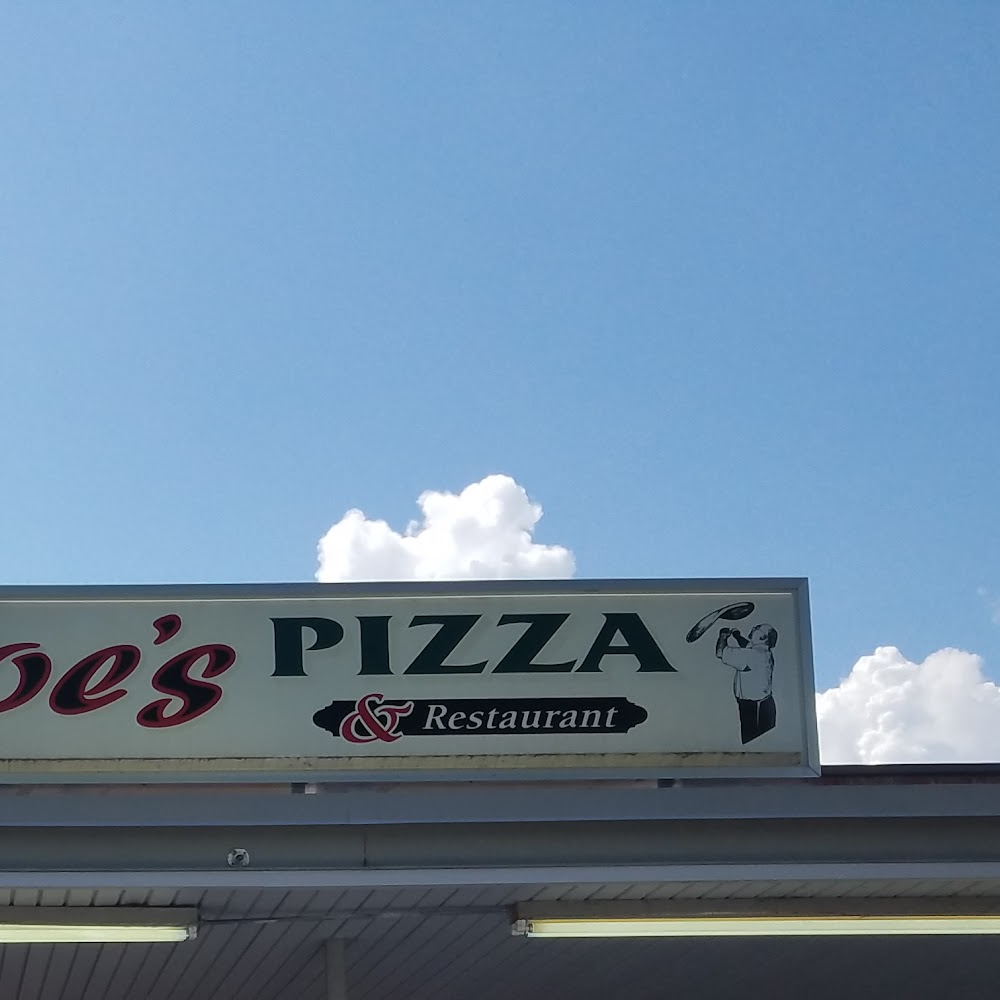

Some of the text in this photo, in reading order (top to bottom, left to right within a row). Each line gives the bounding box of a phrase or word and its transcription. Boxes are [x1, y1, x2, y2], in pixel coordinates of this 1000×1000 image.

[269, 612, 679, 677] PIZZA
[340, 693, 620, 743] & Restaurant
